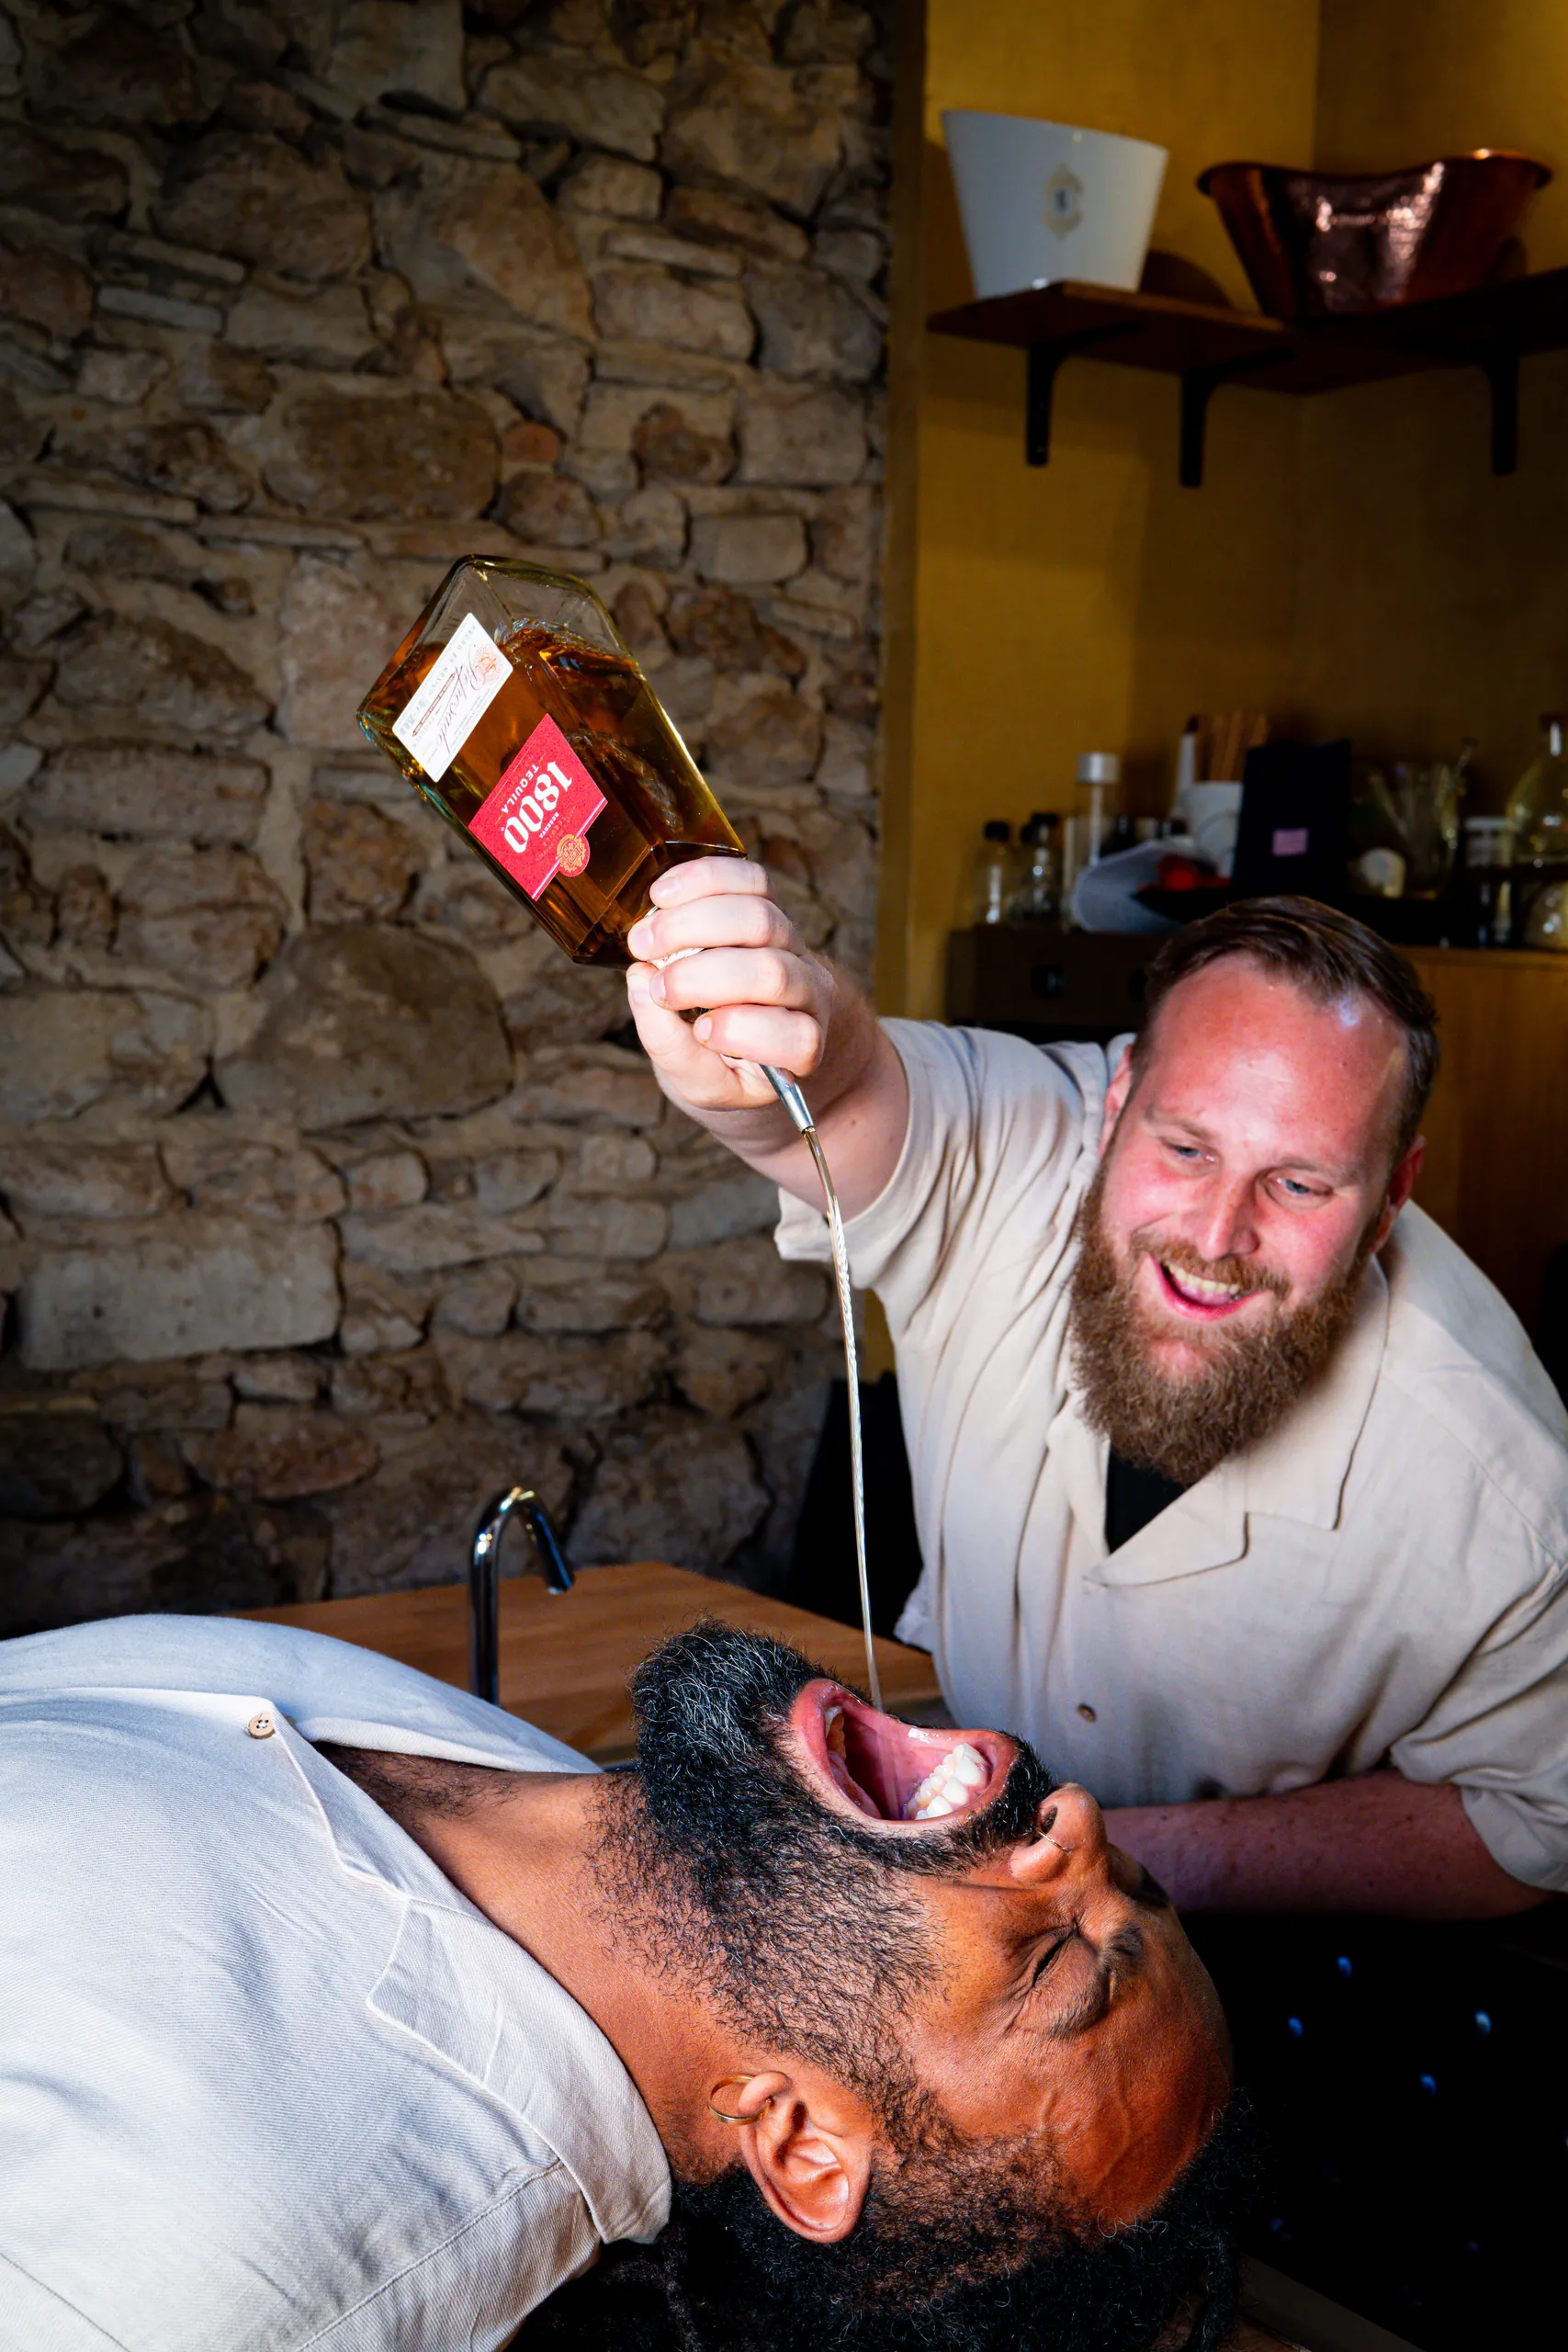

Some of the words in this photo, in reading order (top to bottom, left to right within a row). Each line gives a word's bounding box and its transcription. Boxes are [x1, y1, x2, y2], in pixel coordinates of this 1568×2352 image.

[436, 645, 486, 754] Reposado
[500, 762, 539, 816] TEQUILA
[504, 761, 571, 854] 1800
[537, 810, 559, 840] RESERVA
